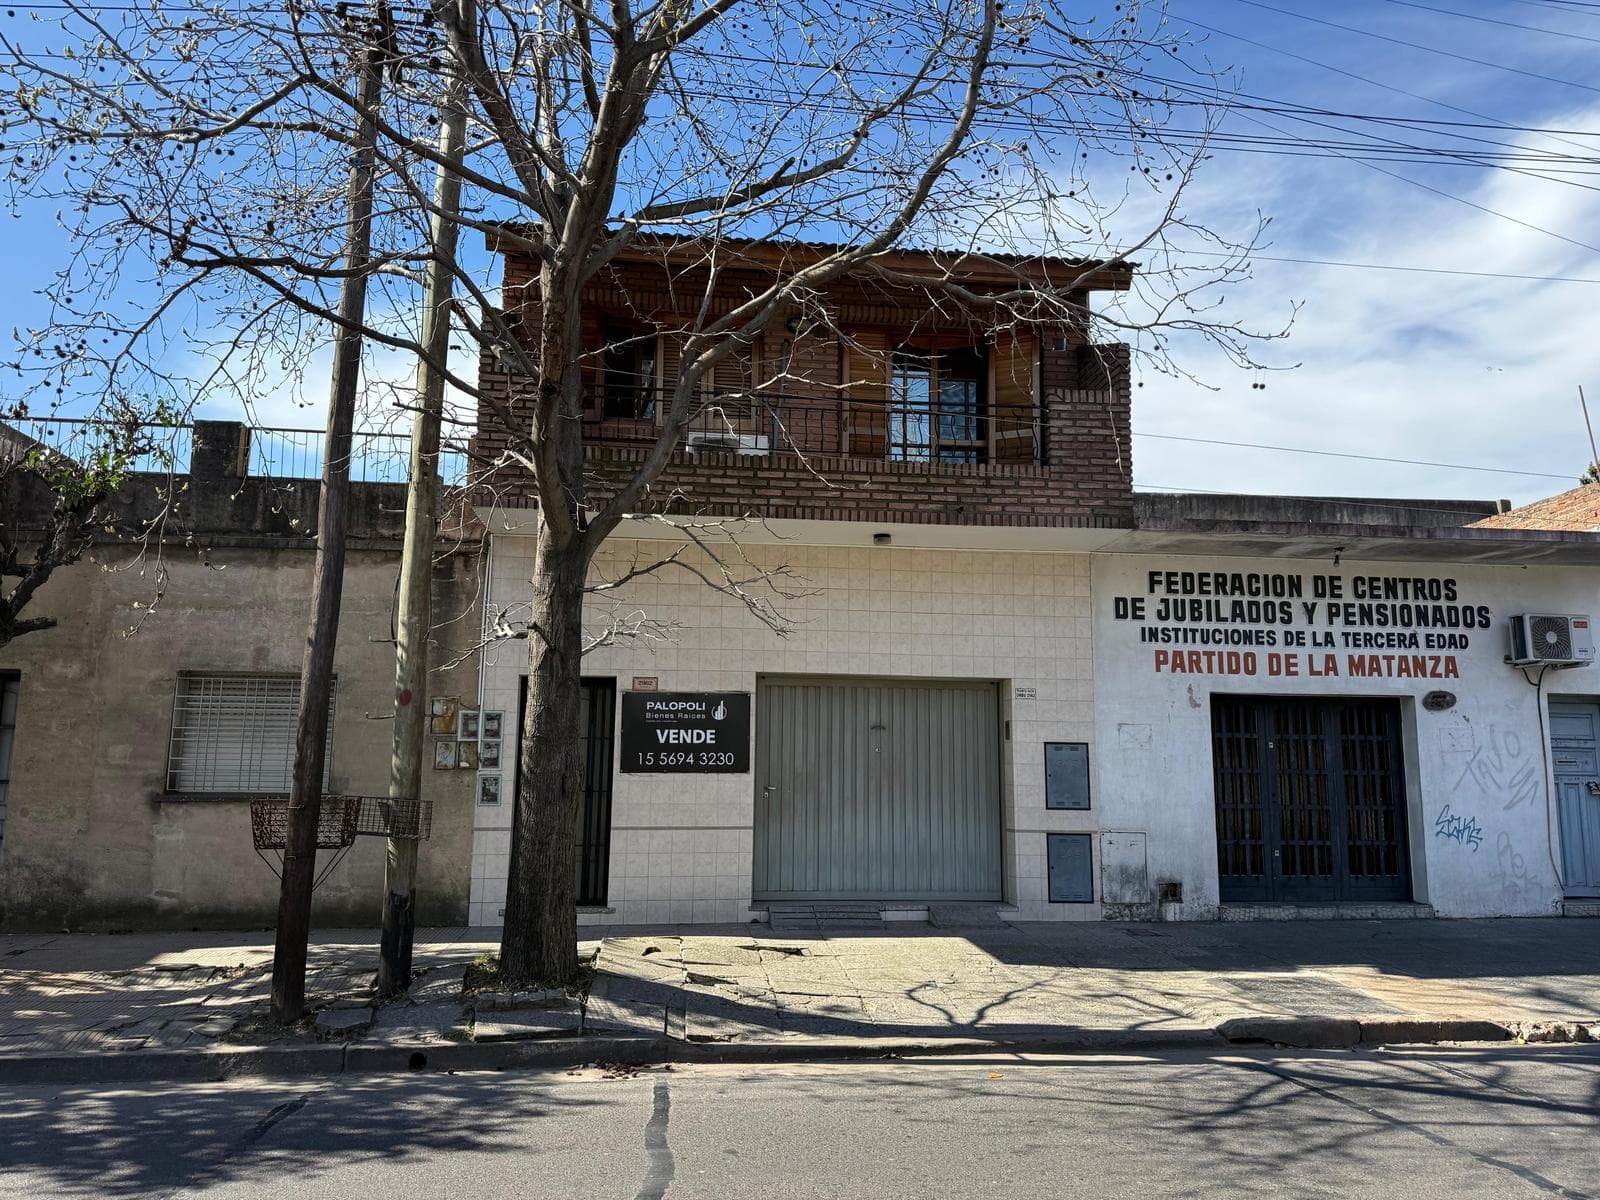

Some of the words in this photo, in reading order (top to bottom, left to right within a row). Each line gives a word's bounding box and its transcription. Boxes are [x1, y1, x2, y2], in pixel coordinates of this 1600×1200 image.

[1148, 571, 1302, 598] FEDERACION
[1313, 575, 1343, 599] DE
[1353, 576, 1458, 601] CENTROS
[1114, 597, 1146, 620] DE
[1157, 598, 1293, 625] JUBILADOS
[1303, 602, 1318, 625] Y
[1327, 603, 1491, 629] PENSIONADOS
[1141, 627, 1277, 646] INSTITUCIONES
[1284, 630, 1306, 647] DE
[1312, 631, 1336, 648] LA
[1342, 632, 1420, 649] TERCERA
[1425, 633, 1469, 650] EDAD
[1155, 649, 1257, 676] PARTIDO
[1268, 653, 1299, 676] DE
[1308, 654, 1339, 677] LA
[1348, 655, 1460, 678] MATANZA
[646, 701, 706, 711] PALOPOLI
[656, 729, 716, 744] VENDE
[638, 752, 654, 765] 15
[659, 752, 694, 765] 5694
[699, 752, 734, 765] 3230
